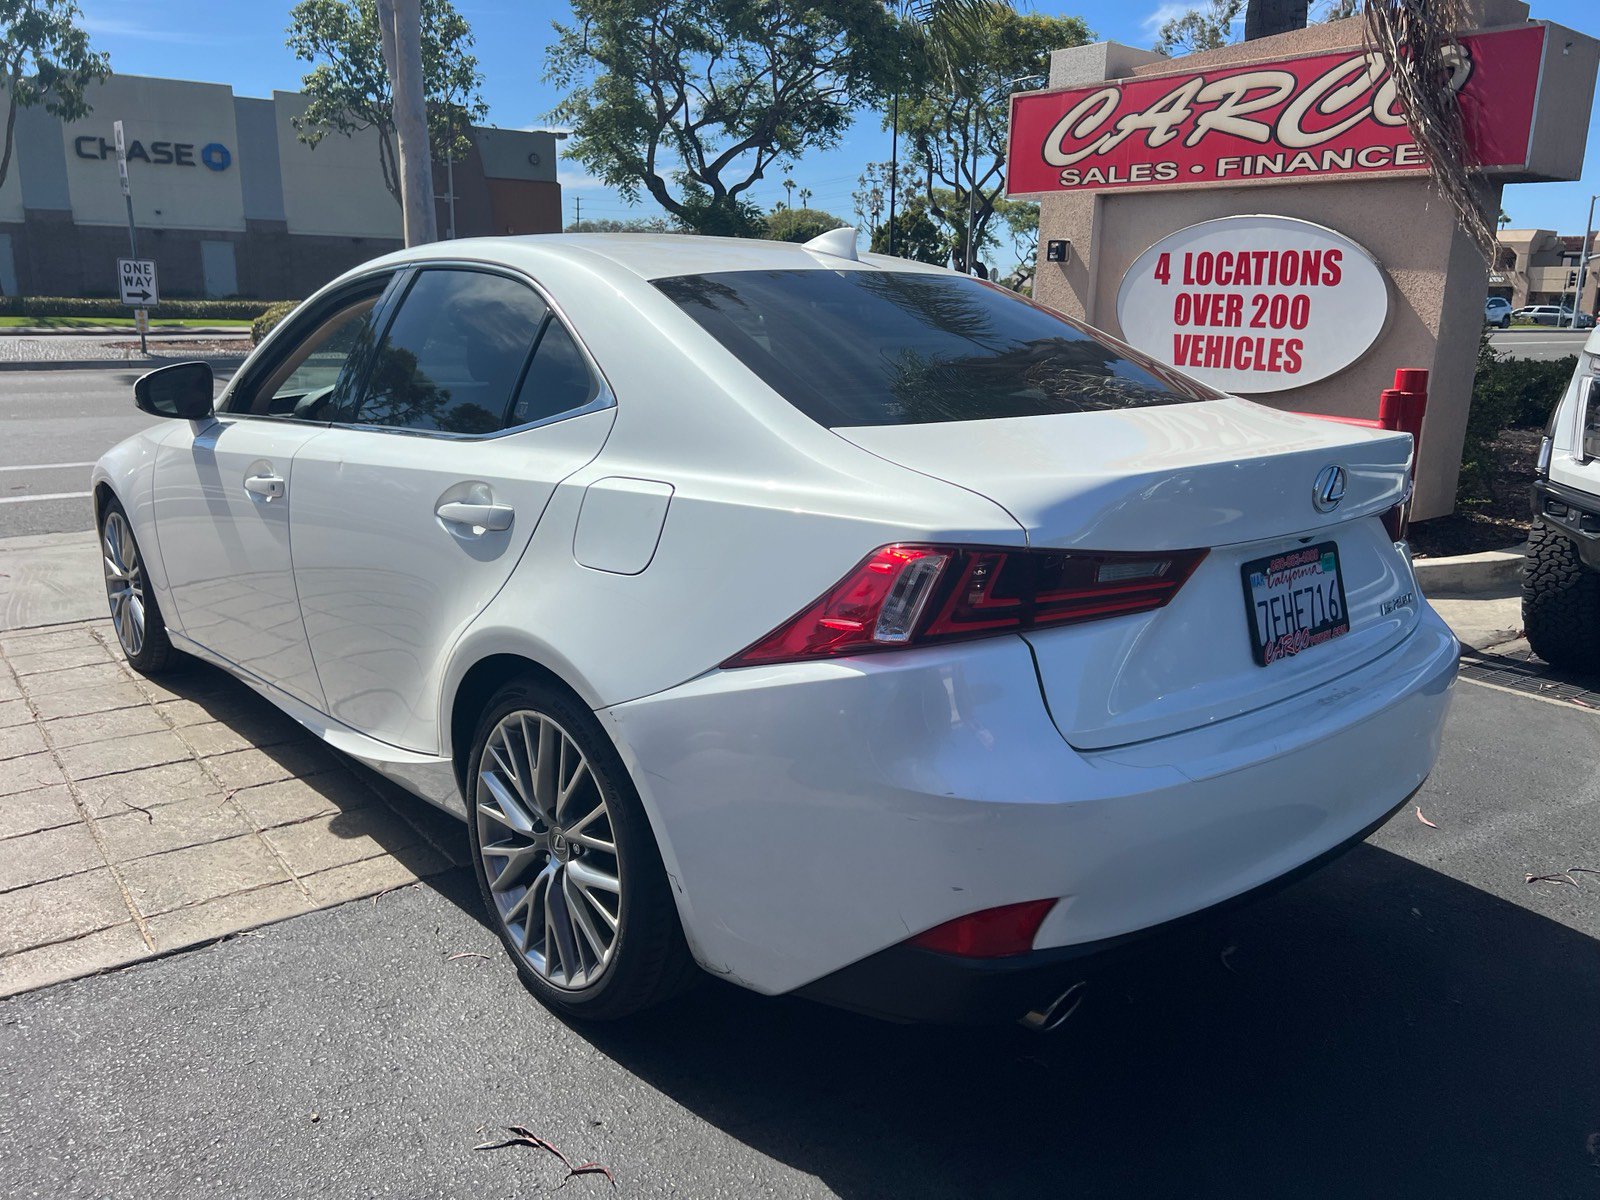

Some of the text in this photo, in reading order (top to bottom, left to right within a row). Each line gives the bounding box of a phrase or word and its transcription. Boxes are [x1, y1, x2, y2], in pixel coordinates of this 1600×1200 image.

[75, 135, 196, 167] CHASE
[1060, 143, 1429, 187] SALES FINANCE
[123, 262, 151, 275] ONE
[123, 276, 152, 287] WAY
[1154, 249, 1342, 287] 4 LOCATIONS
[1174, 292, 1310, 330] OVER 200
[1173, 333, 1303, 374] VEHICLES
[1265, 563, 1325, 589] California
[1257, 579, 1339, 644] 7EHE716
